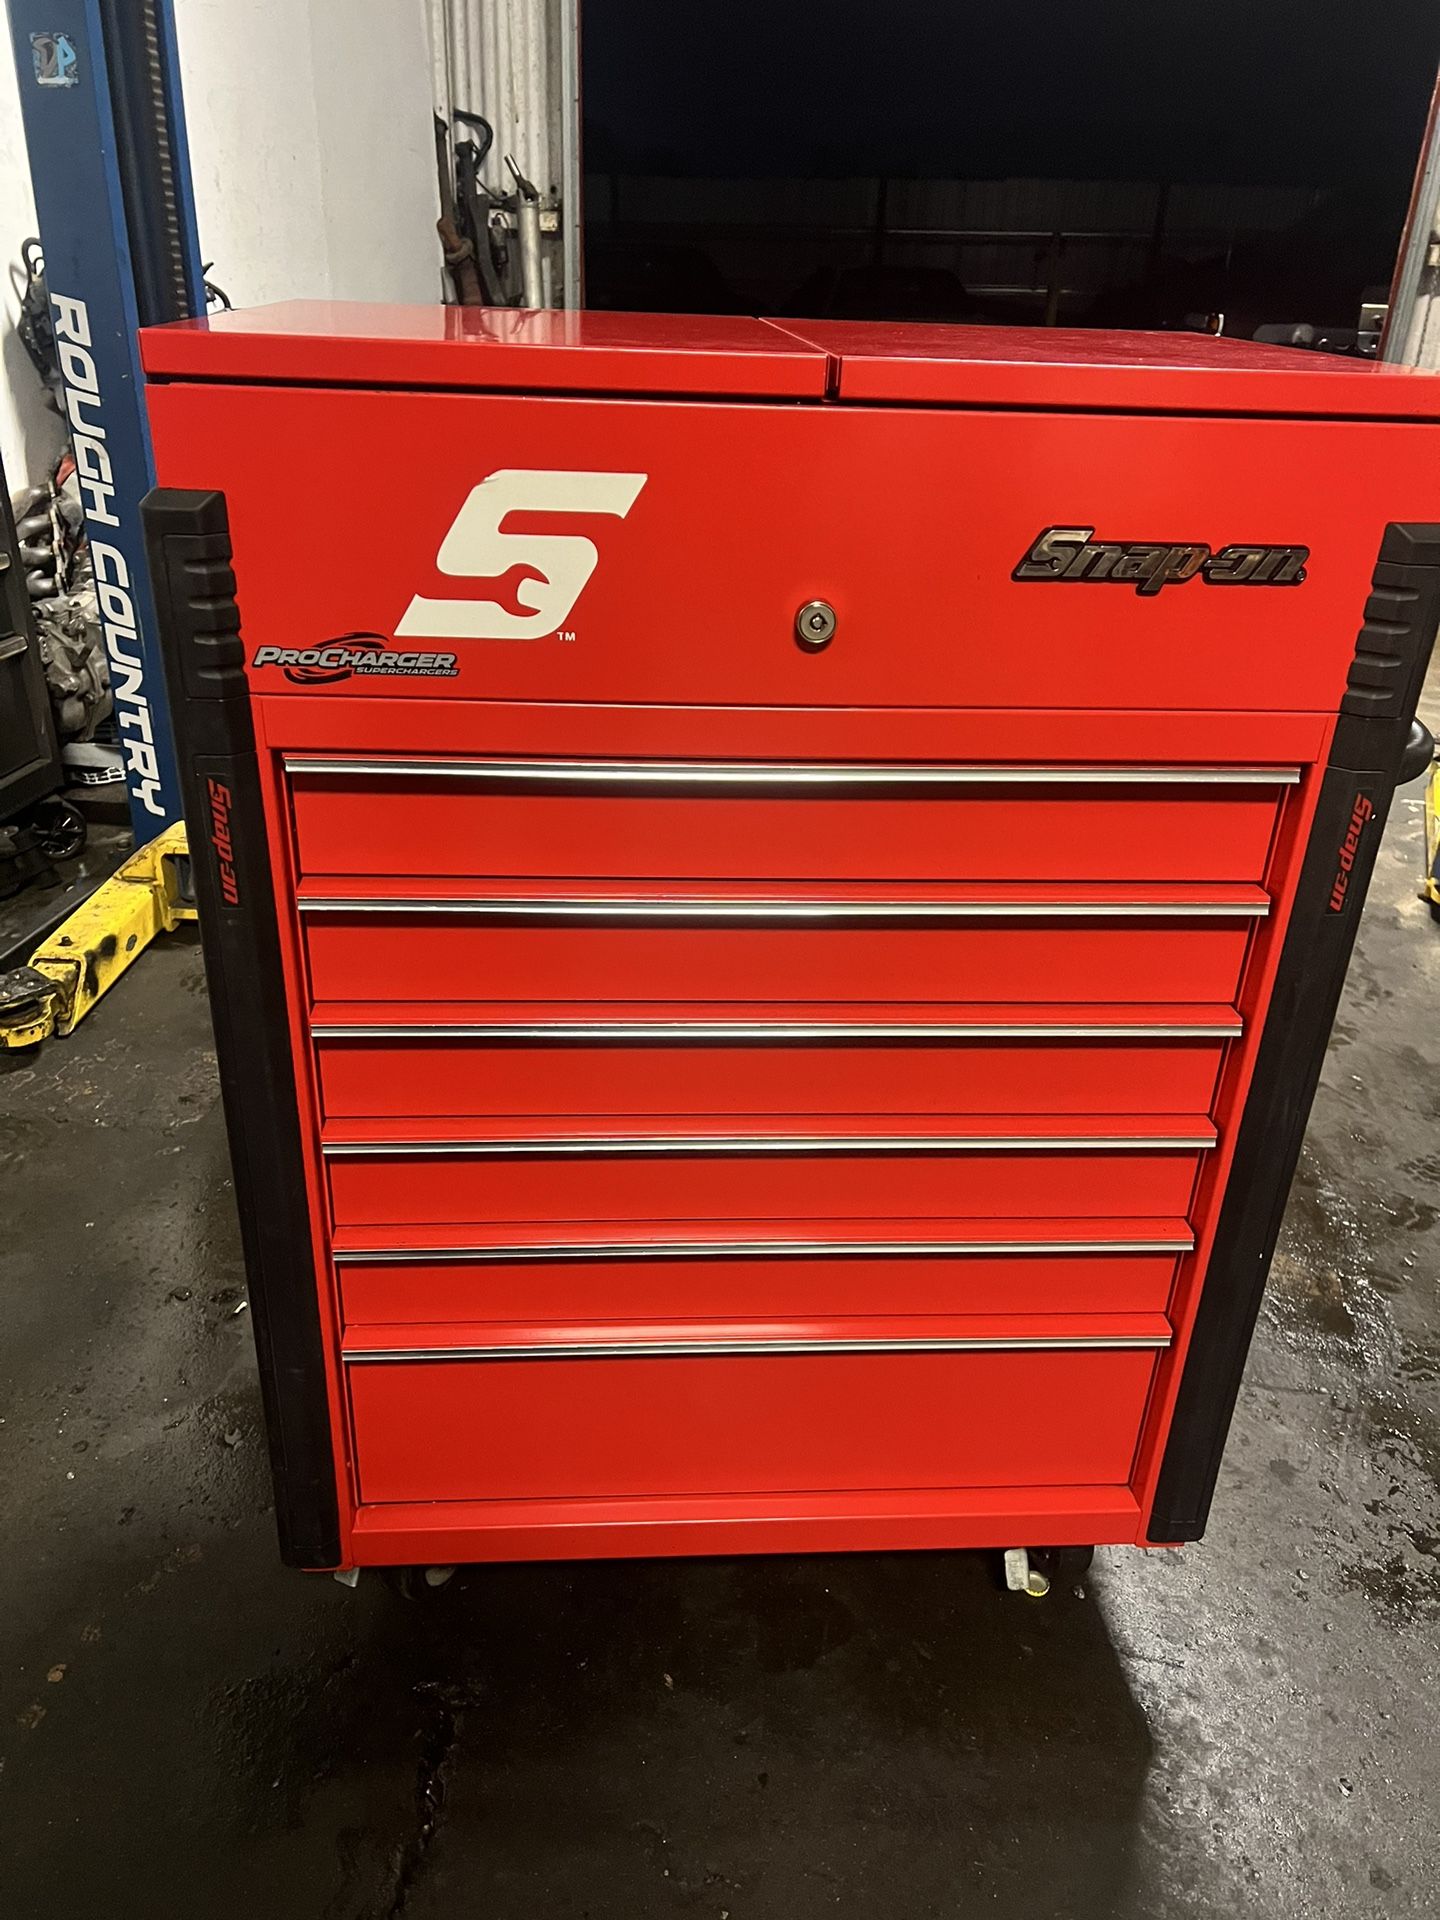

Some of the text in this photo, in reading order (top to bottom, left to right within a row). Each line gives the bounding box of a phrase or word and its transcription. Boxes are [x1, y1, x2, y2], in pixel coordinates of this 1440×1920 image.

[50, 292, 166, 817] ROUGH COUNTRY
[556, 631, 576, 642] TM
[355, 667, 459, 677] SUPERCHARGERS
